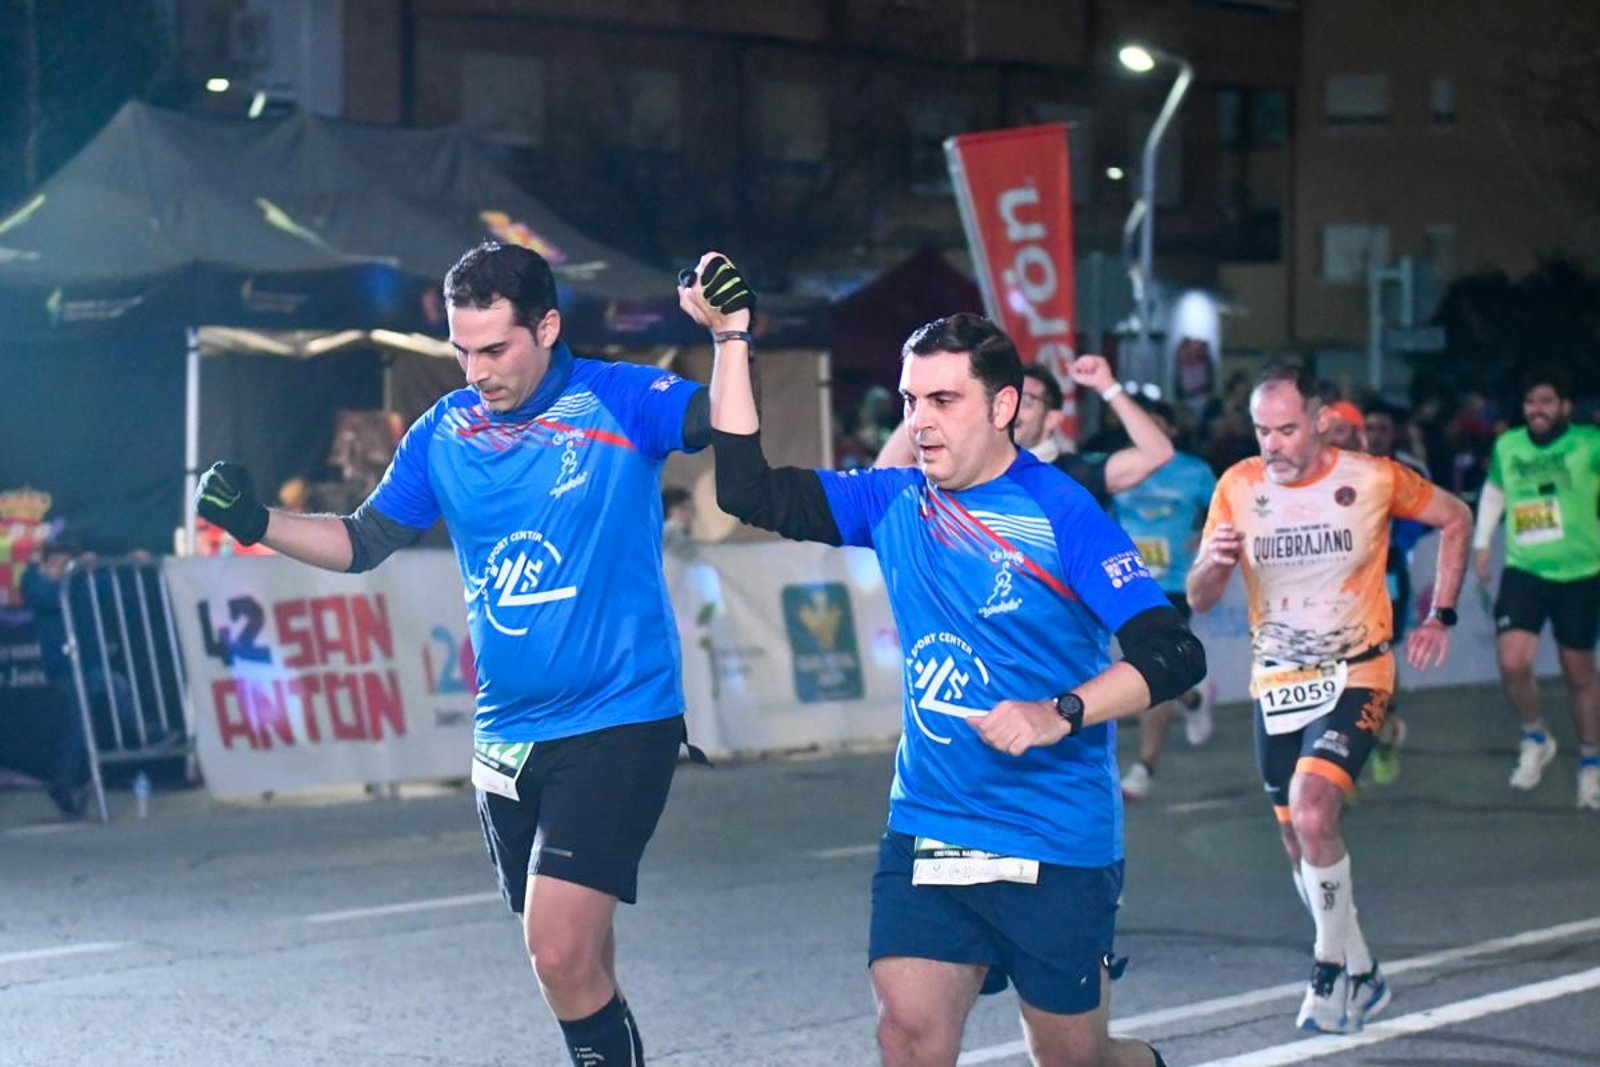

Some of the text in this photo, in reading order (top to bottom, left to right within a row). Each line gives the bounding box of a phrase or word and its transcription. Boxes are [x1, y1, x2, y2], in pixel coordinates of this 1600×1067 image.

[1254, 529, 1353, 563] QUIEBRAJANO
[198, 593, 394, 668] 42 SAN
[939, 632, 973, 655] CENTER
[1264, 680, 1336, 708] 12059
